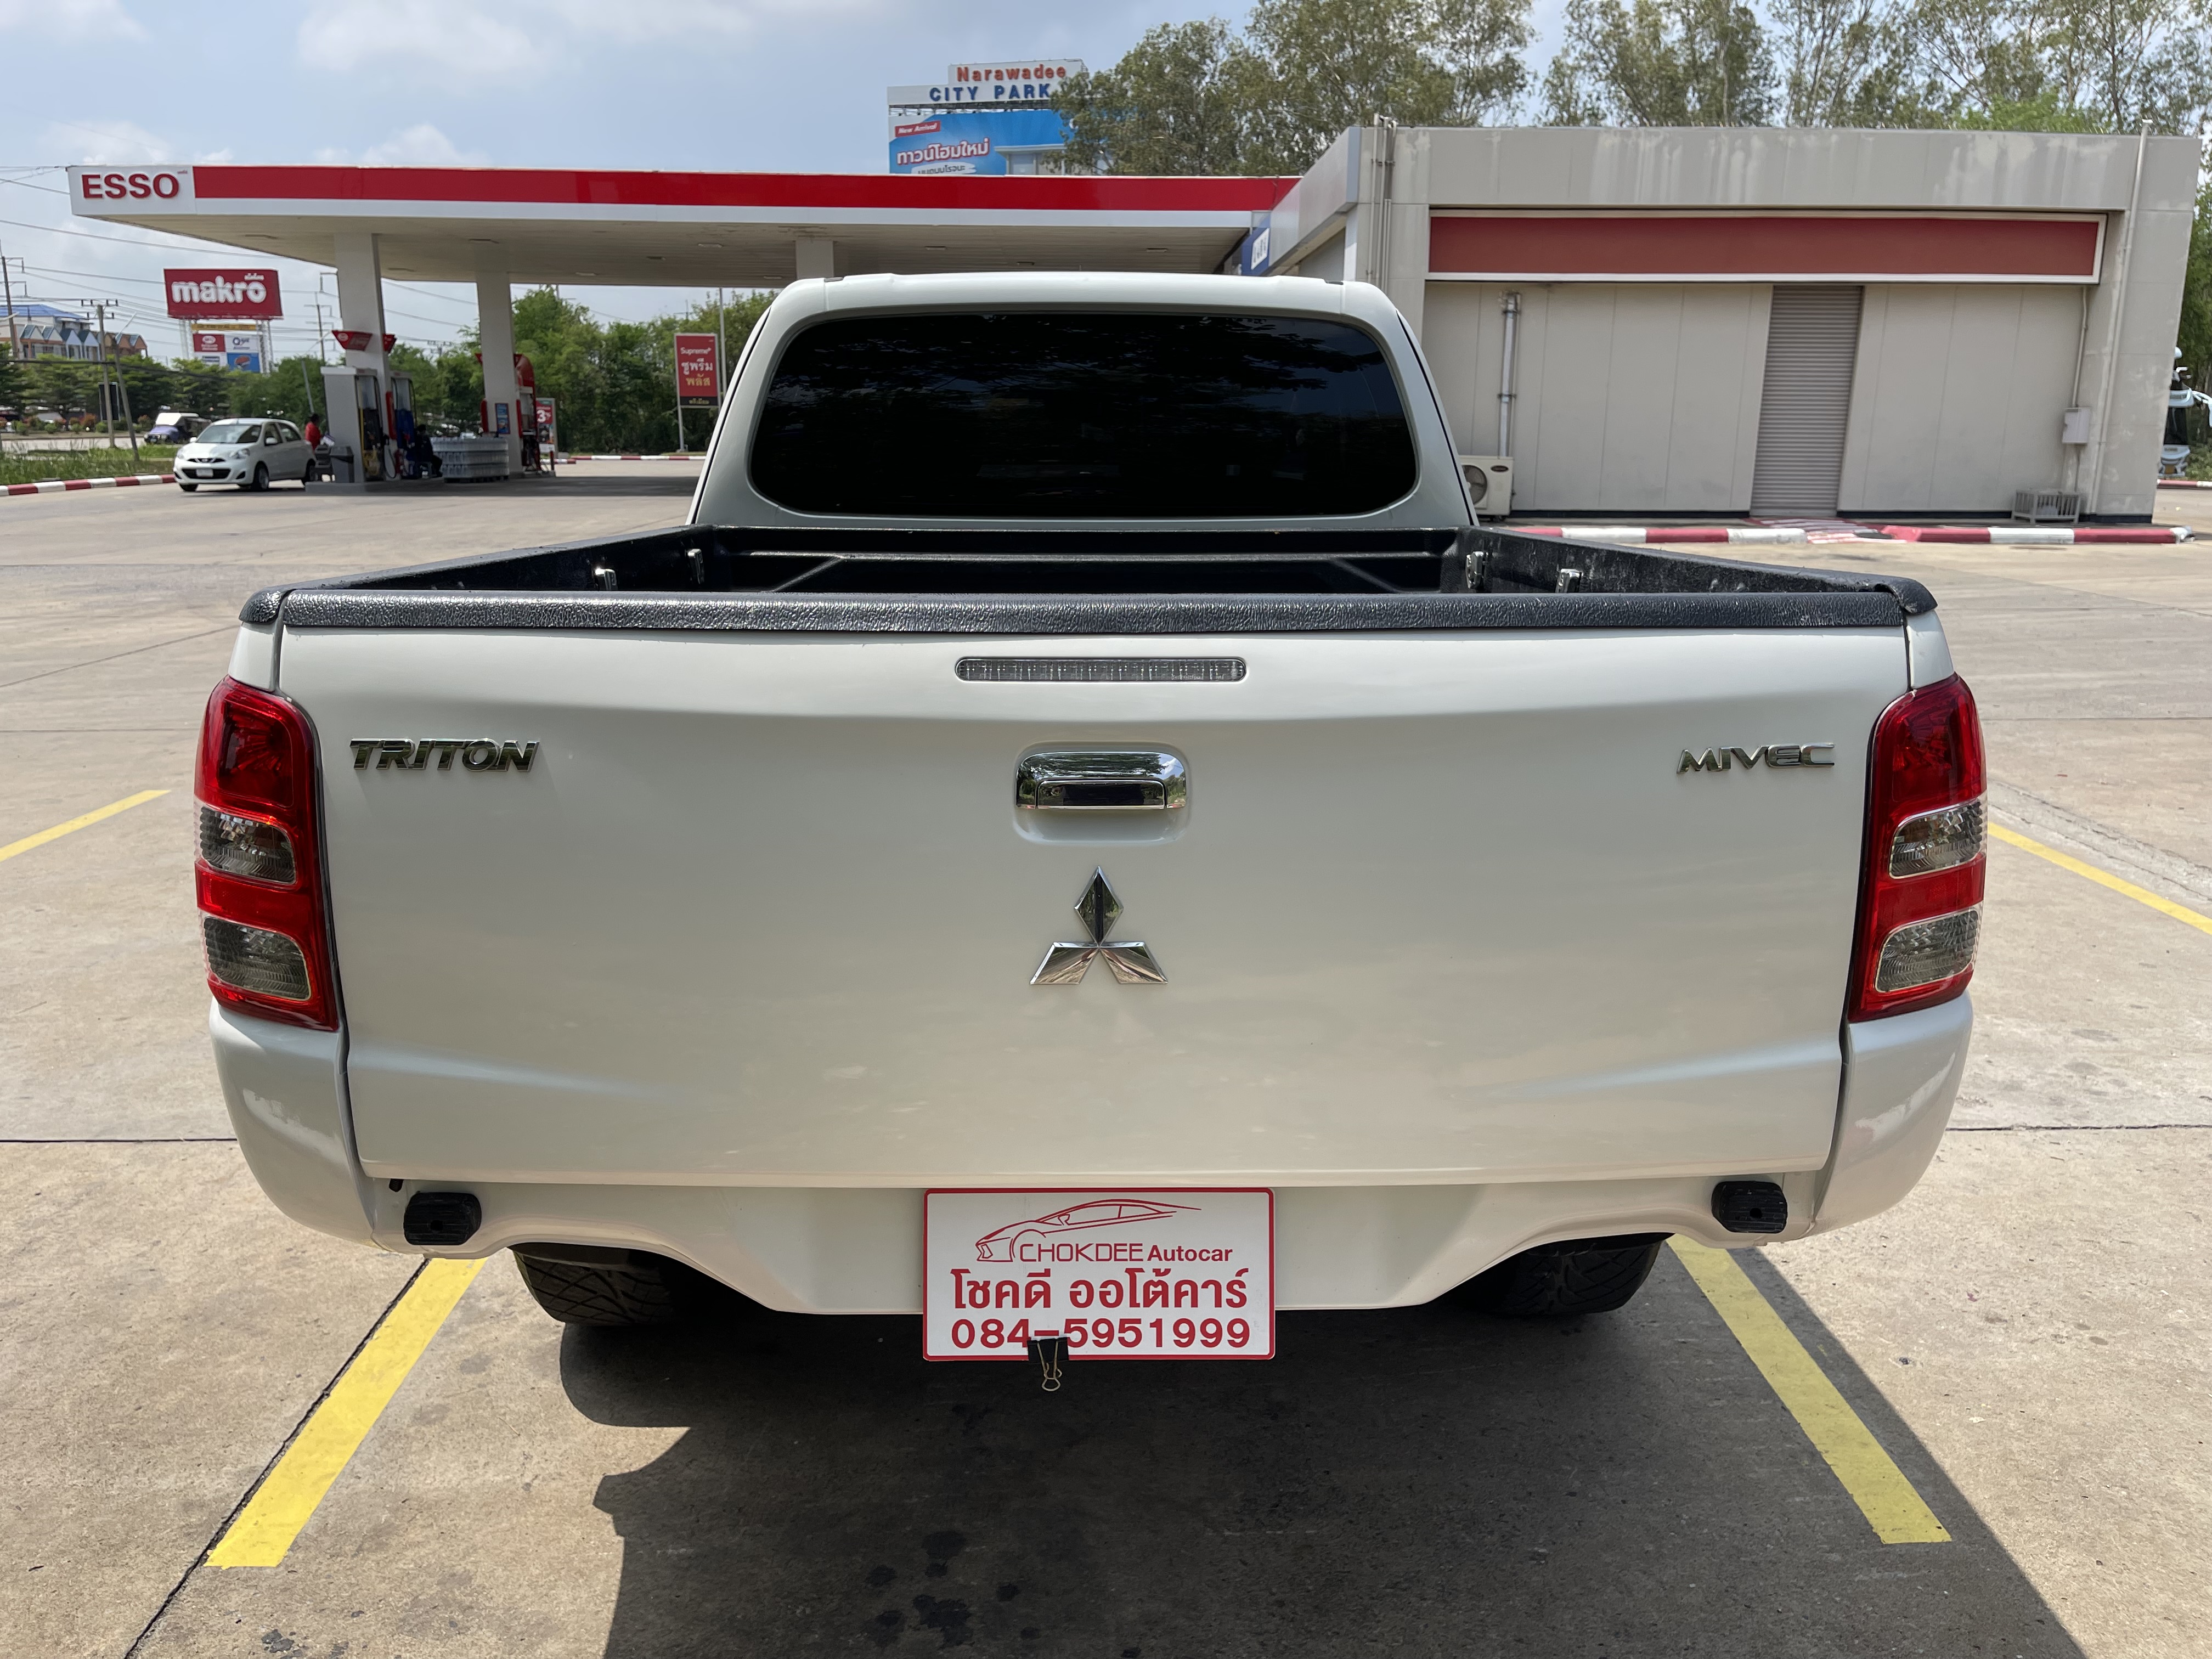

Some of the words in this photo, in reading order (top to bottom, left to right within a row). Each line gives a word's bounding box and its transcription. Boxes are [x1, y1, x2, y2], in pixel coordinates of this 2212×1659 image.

[957, 64, 1066, 82] Narawadee
[929, 86, 978, 101] CITY
[994, 83, 1050, 99] PARK
[81, 173, 180, 199] ESSO
[171, 275, 267, 303] makro
[350, 738, 540, 772] TRITON
[1676, 742, 1835, 774] MIVEC
[1019, 1243, 1143, 1262] CHOKDEE
[1147, 1244, 1233, 1262] Autocar
[950, 1268, 1051, 1309] โชคดี
[1069, 1268, 1249, 1308] ออโต้คาร์
[951, 1318, 1250, 1348] 084-5951999
